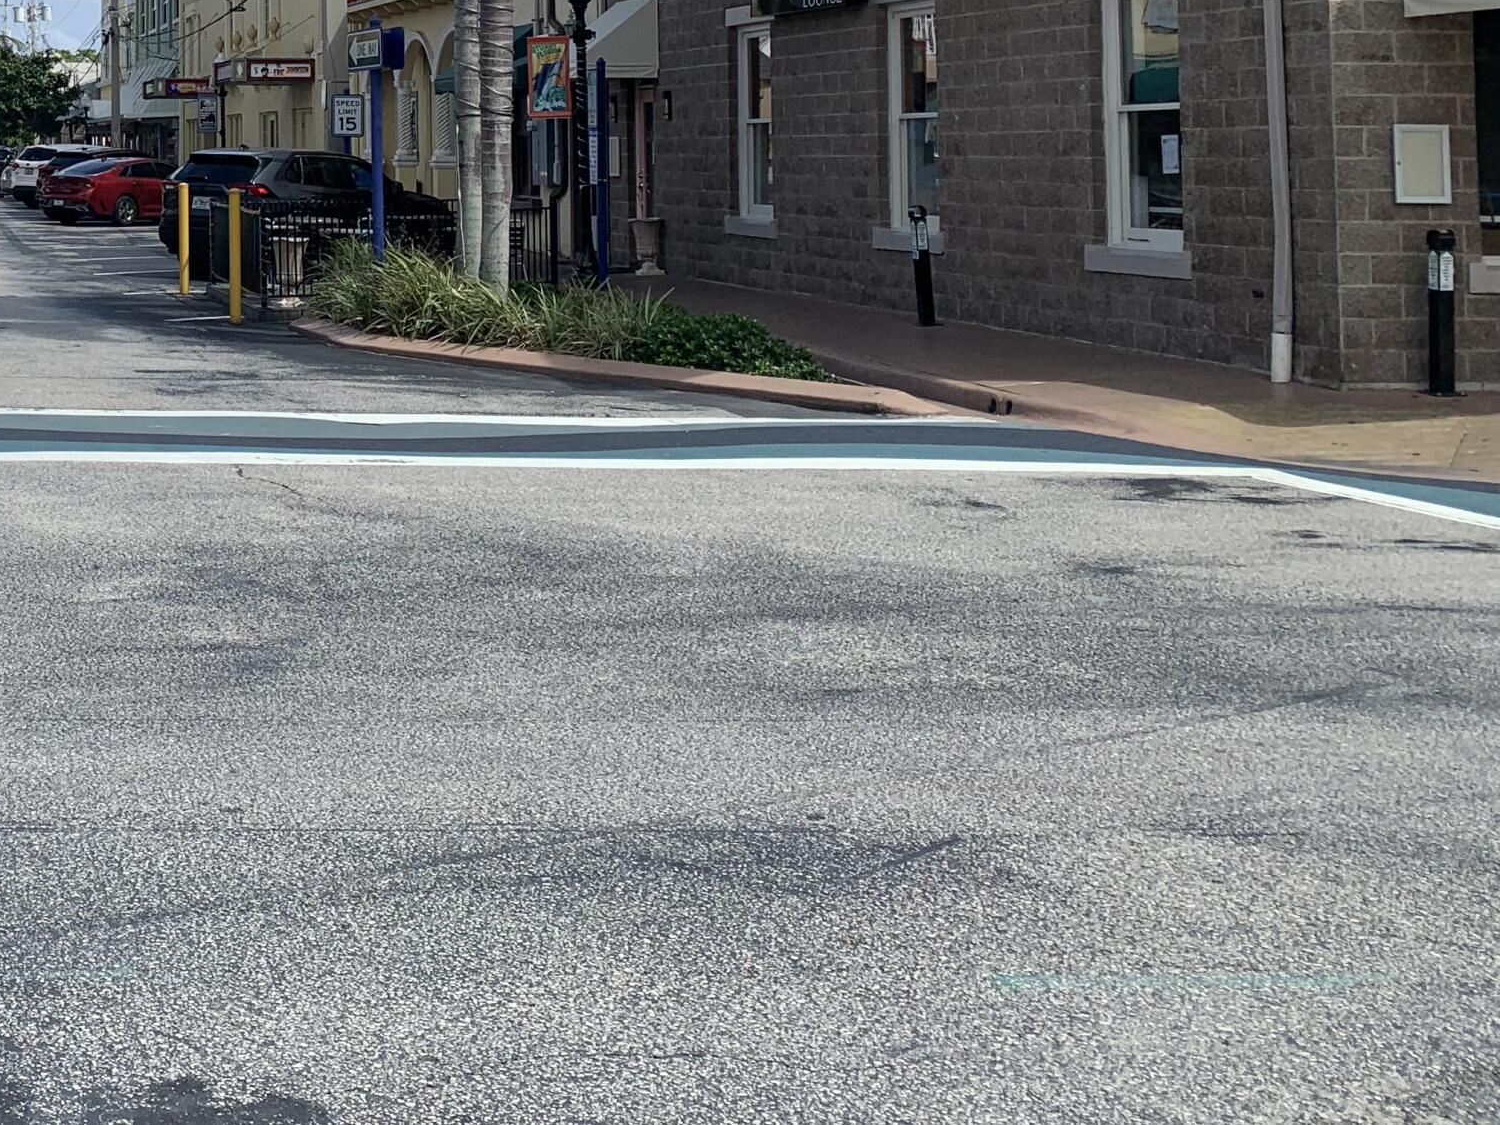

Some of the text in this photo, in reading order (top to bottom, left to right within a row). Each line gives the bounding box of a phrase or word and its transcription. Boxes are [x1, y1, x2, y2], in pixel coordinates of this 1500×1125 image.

[357, 40, 378, 57] ONE WAY
[339, 117, 357, 131] 15
